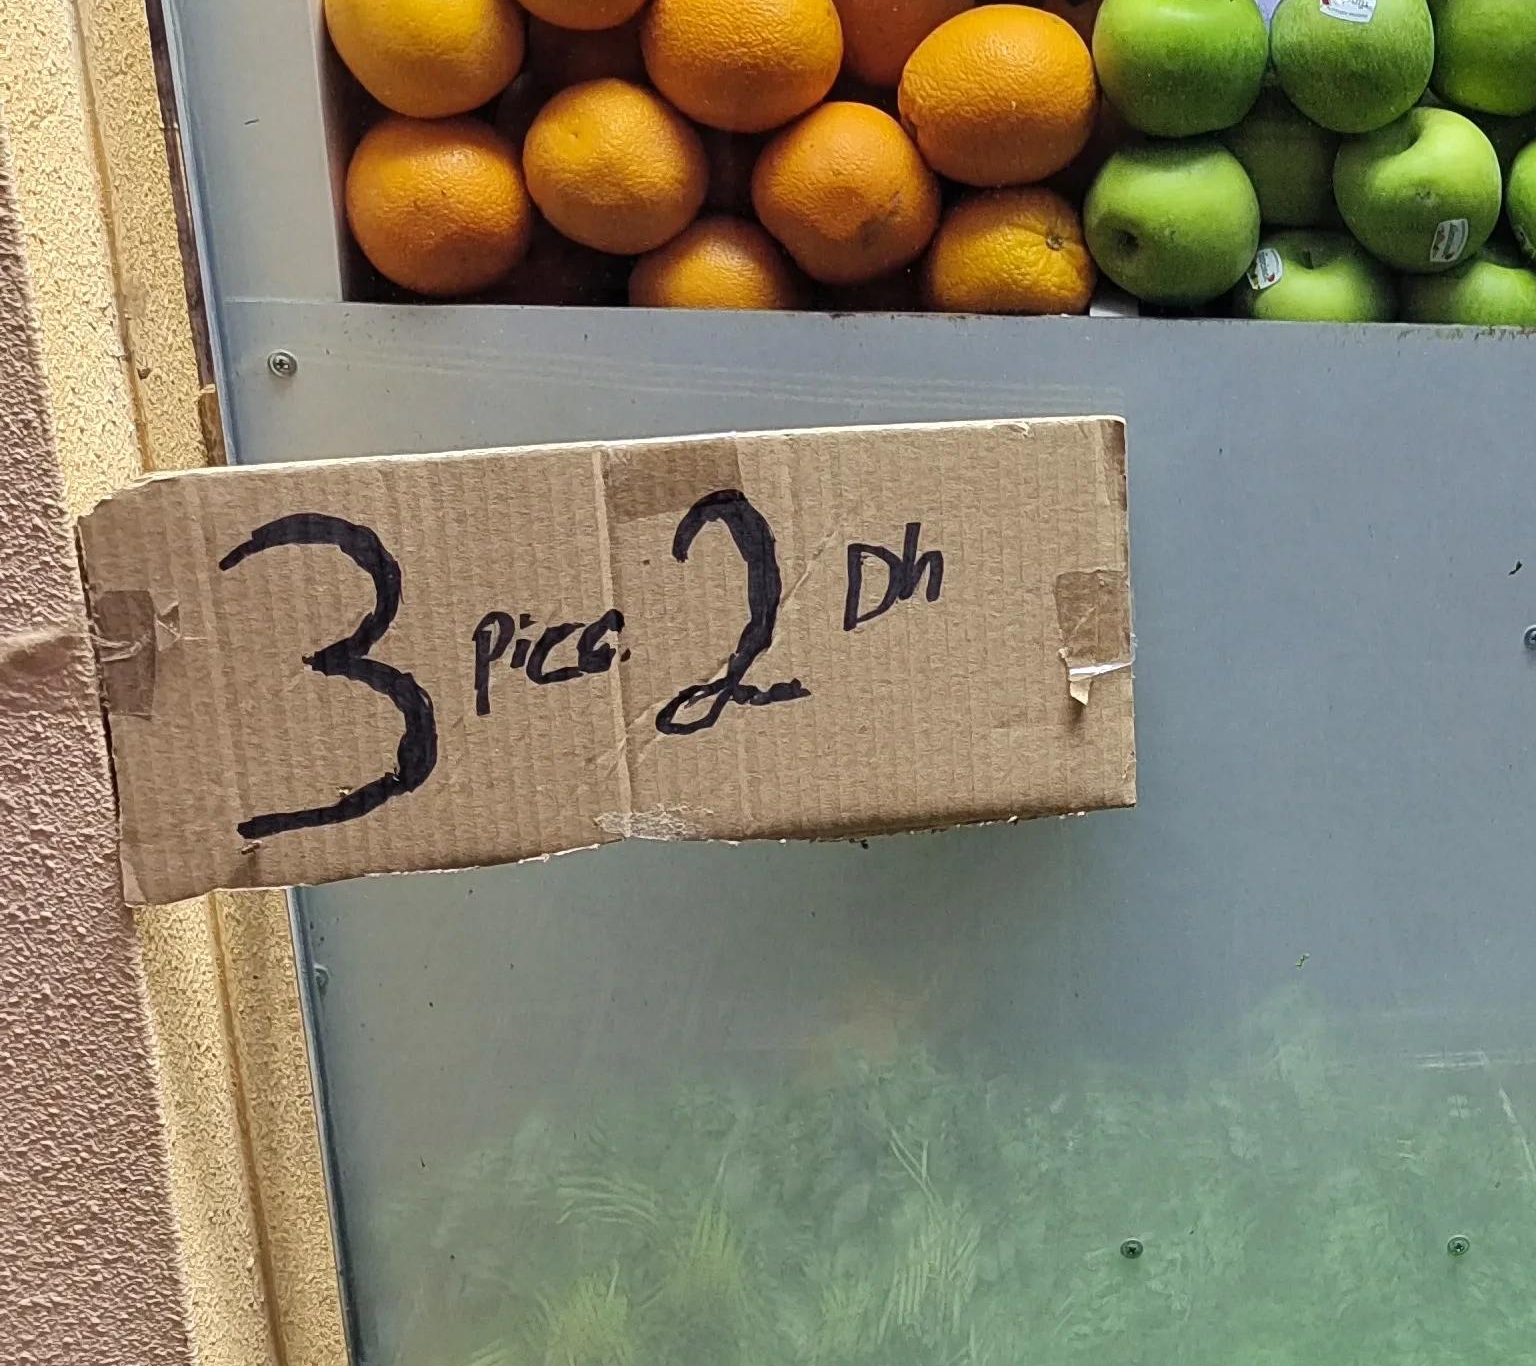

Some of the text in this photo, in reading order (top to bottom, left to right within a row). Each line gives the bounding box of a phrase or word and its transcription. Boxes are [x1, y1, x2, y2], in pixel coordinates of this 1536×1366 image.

[220, 512, 439, 839] 3
[654, 488, 812, 736] 2
[844, 521, 945, 632] Dh
